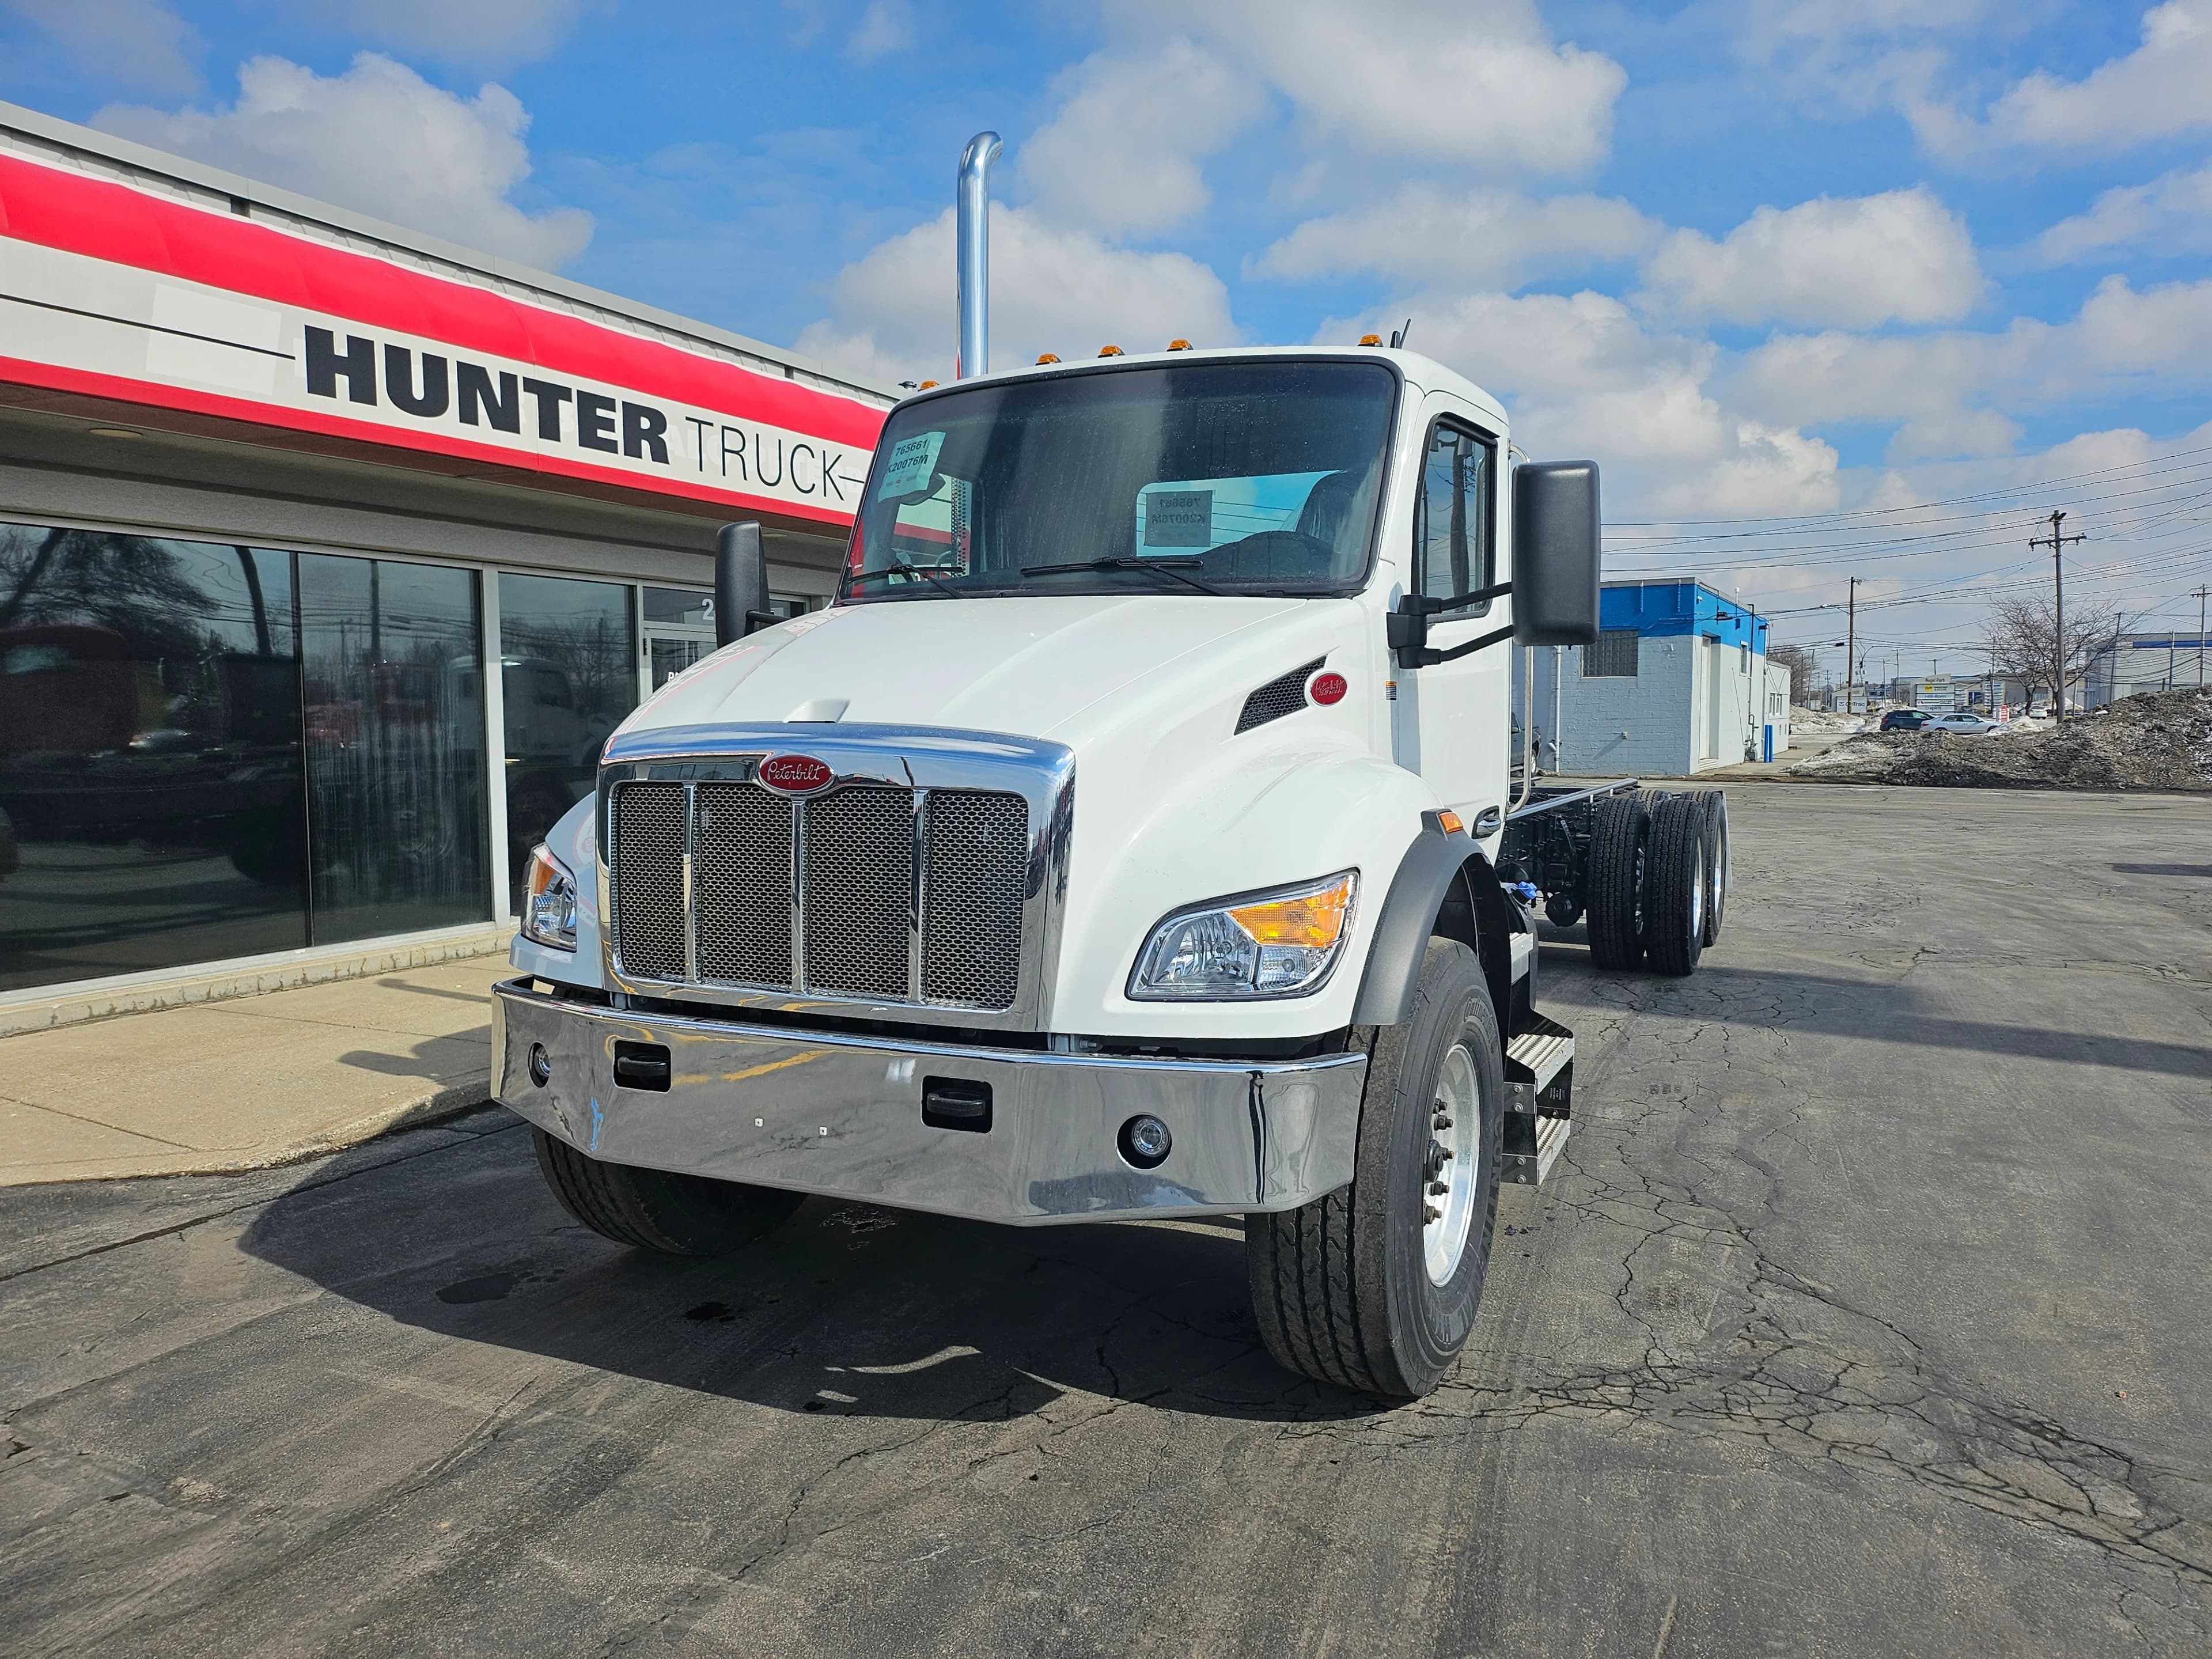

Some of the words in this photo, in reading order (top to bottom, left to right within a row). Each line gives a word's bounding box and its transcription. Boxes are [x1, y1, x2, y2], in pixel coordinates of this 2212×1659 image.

[304, 324, 670, 465] HUNTER
[685, 416, 845, 501] TRUCK
[895, 438, 928, 457] 765661
[702, 598, 715, 621] 2
[767, 761, 825, 782] Peterbilt
